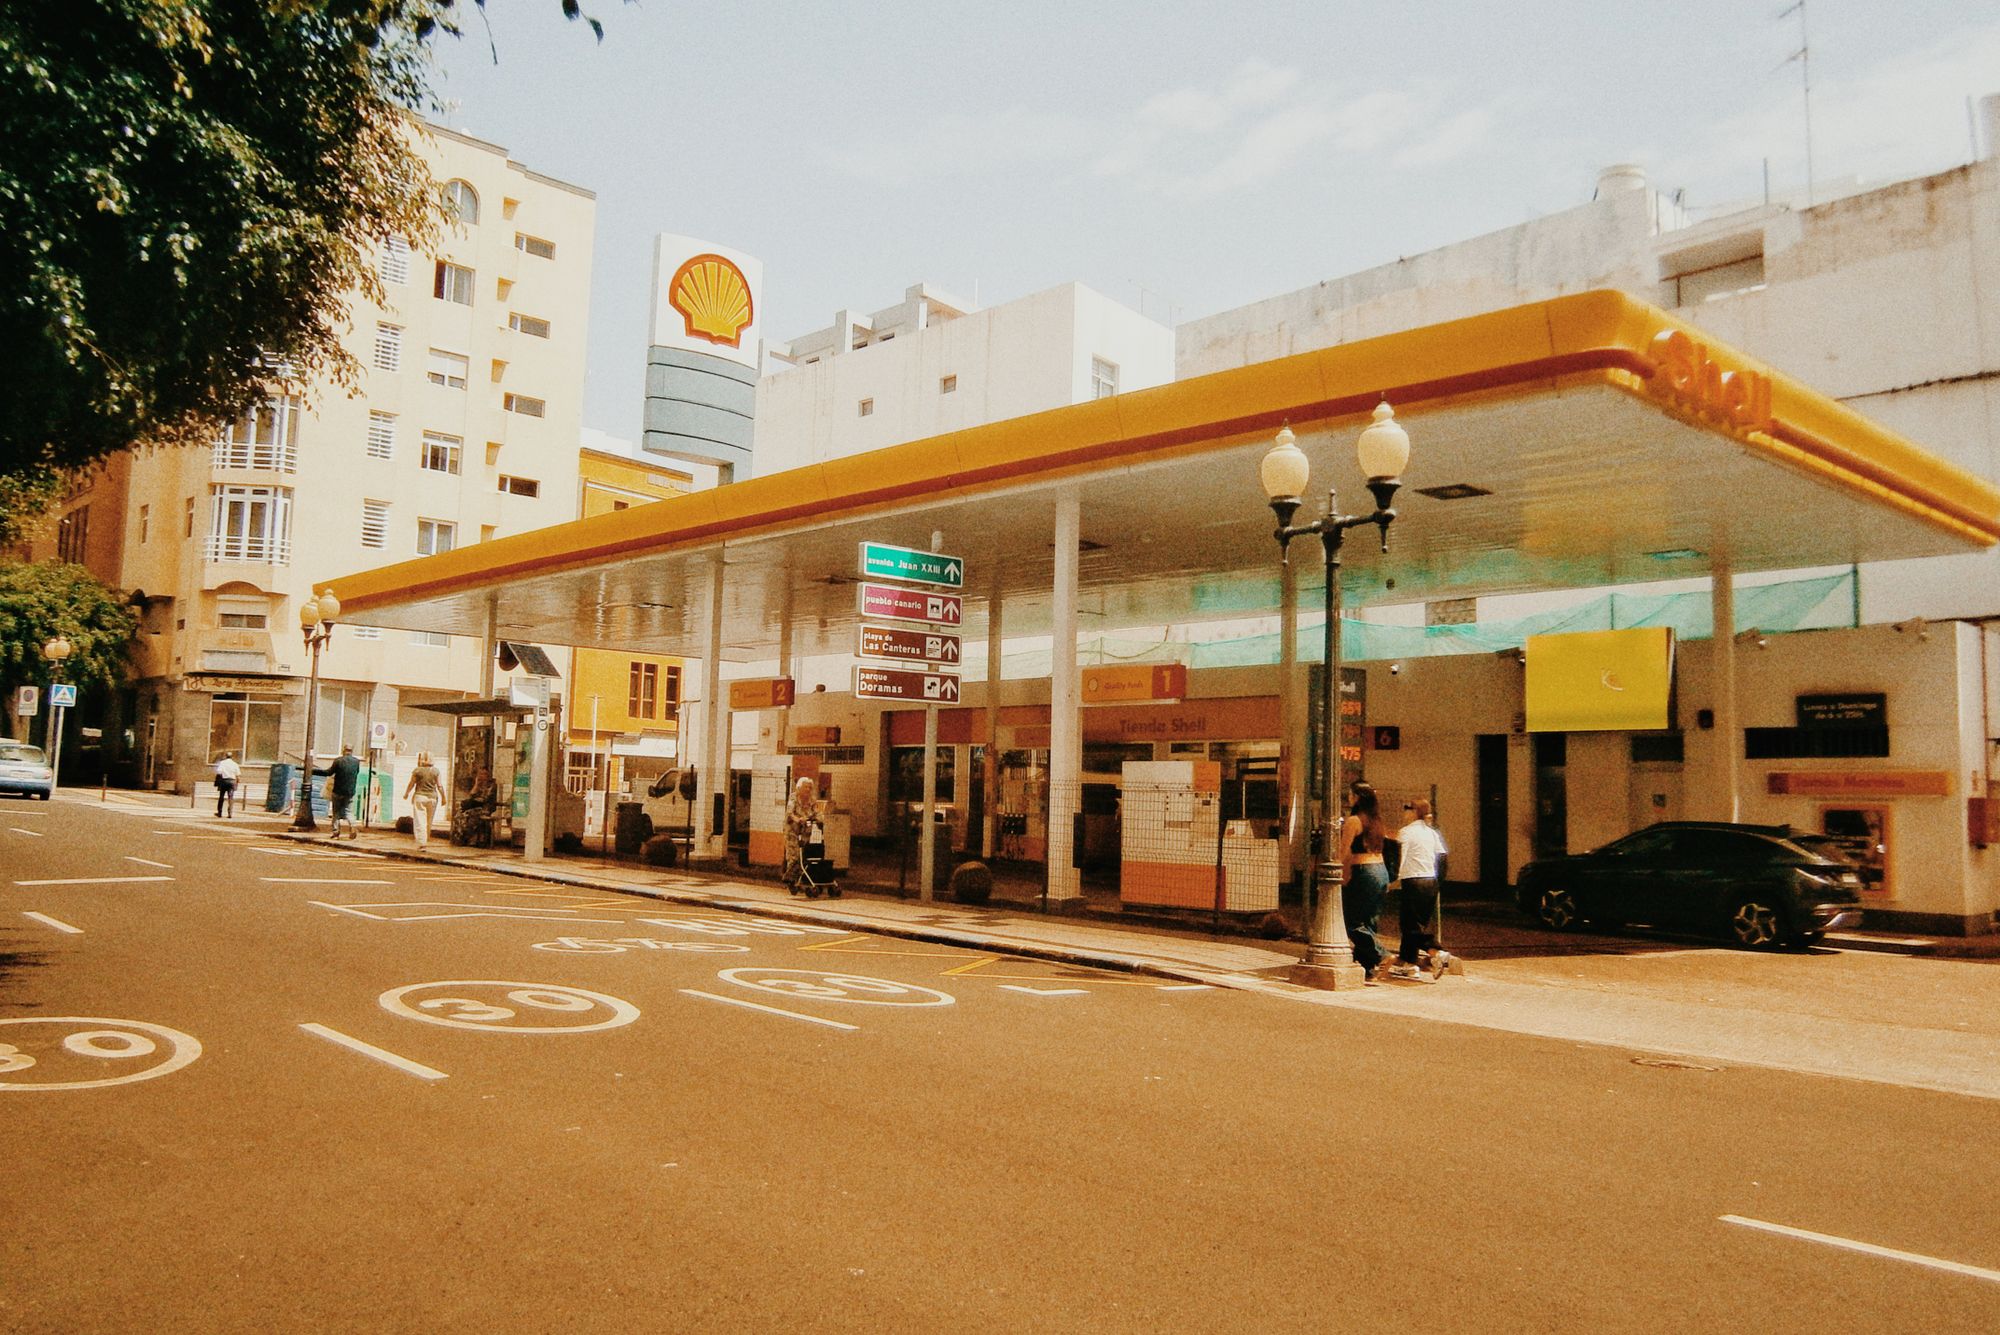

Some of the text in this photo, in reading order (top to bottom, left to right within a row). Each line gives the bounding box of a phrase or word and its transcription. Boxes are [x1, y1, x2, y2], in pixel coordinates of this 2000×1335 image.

[868, 557, 941, 574] avenida Juan XXIII
[865, 596, 922, 610] pueblo canario
[863, 632, 893, 642] playa de
[863, 640, 921, 655] Las Canteras
[860, 672, 888, 682] parque
[1162, 670, 1171, 692] 1
[776, 683, 786, 701] 2
[859, 681, 903, 694] Doramas
[1119, 717, 1206, 733] Tienda Shell
[636, 919, 850, 935] BUS
[758, 977, 909, 997] 30
[418, 989, 596, 1021] 30
